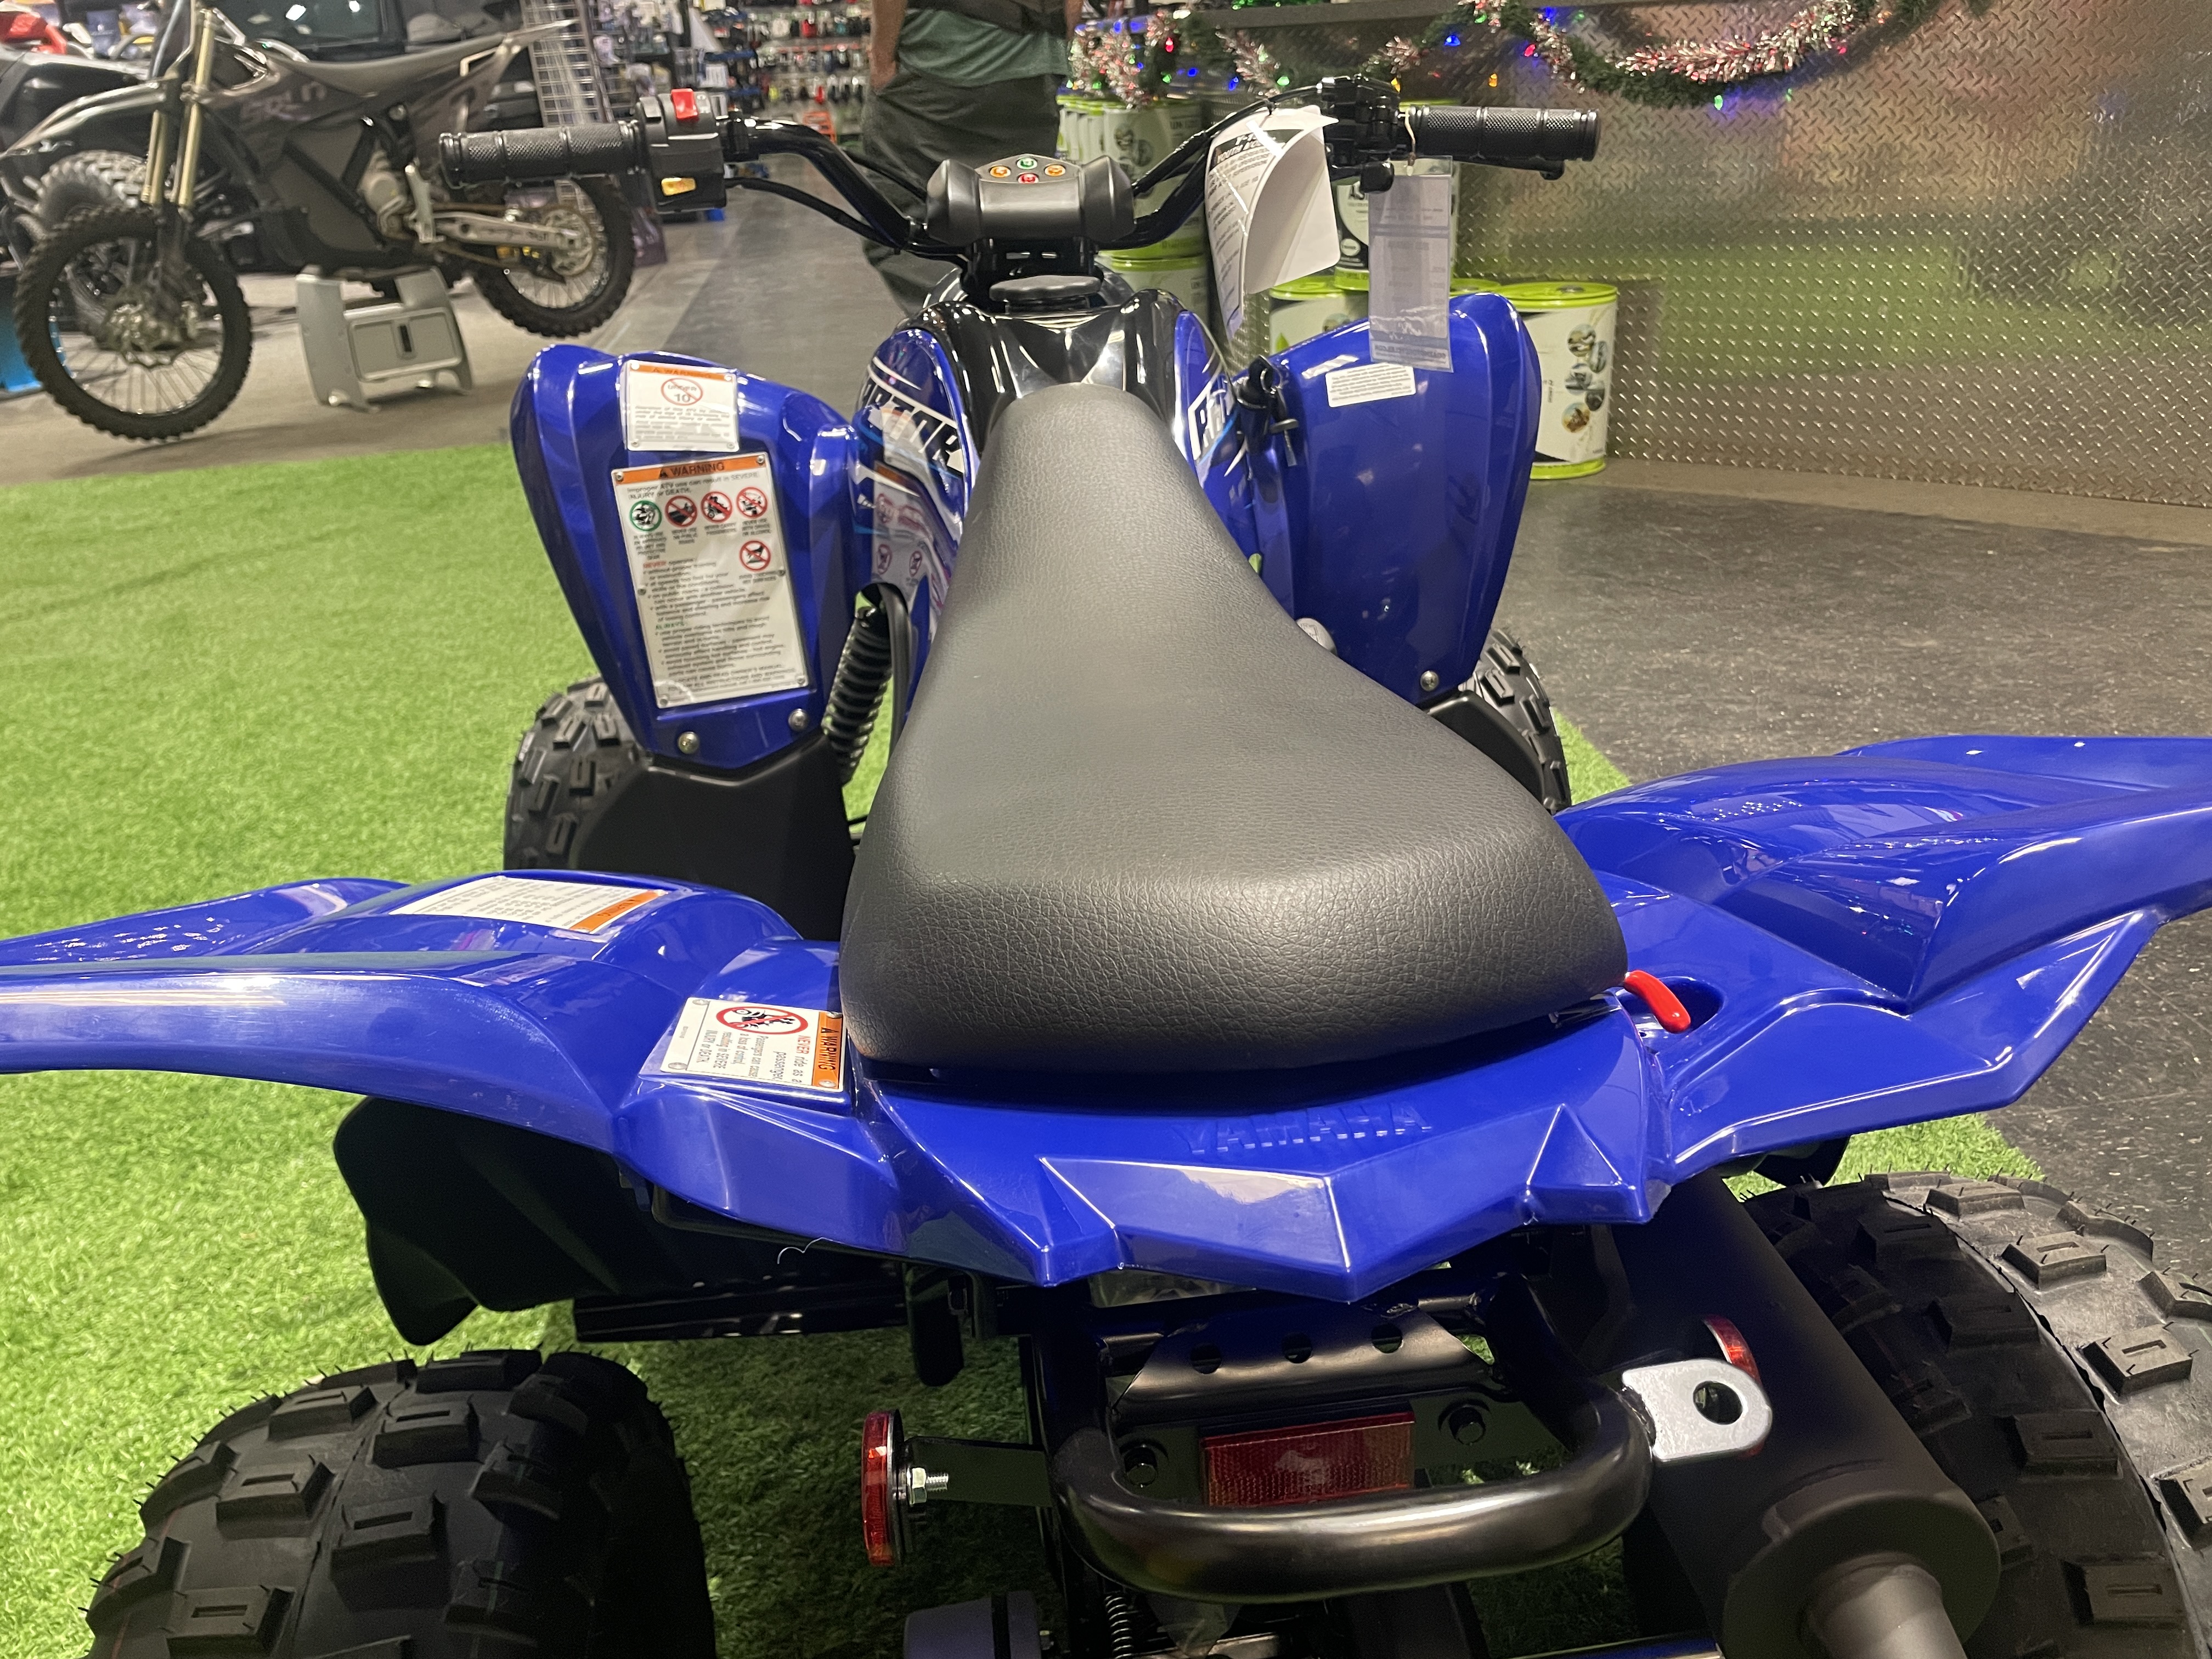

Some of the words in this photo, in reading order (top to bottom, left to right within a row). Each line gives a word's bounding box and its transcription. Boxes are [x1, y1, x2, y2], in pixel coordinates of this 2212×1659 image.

[674, 393, 691, 403] 10
[670, 462, 724, 476] WARNING
[703, 1029, 718, 1043] INJURY
[715, 1031, 733, 1047] resulting
[751, 1035, 769, 1056] Passengers
[796, 1035, 811, 1054] NEVER
[713, 1053, 730, 1069] SEVERE
[818, 1036, 838, 1070] WARNING
[769, 1051, 787, 1080] passenger.
[794, 1056, 808, 1067] ride
[748, 1065, 760, 1077] cause
[1171, 1102, 1432, 1154] YAMAHA
